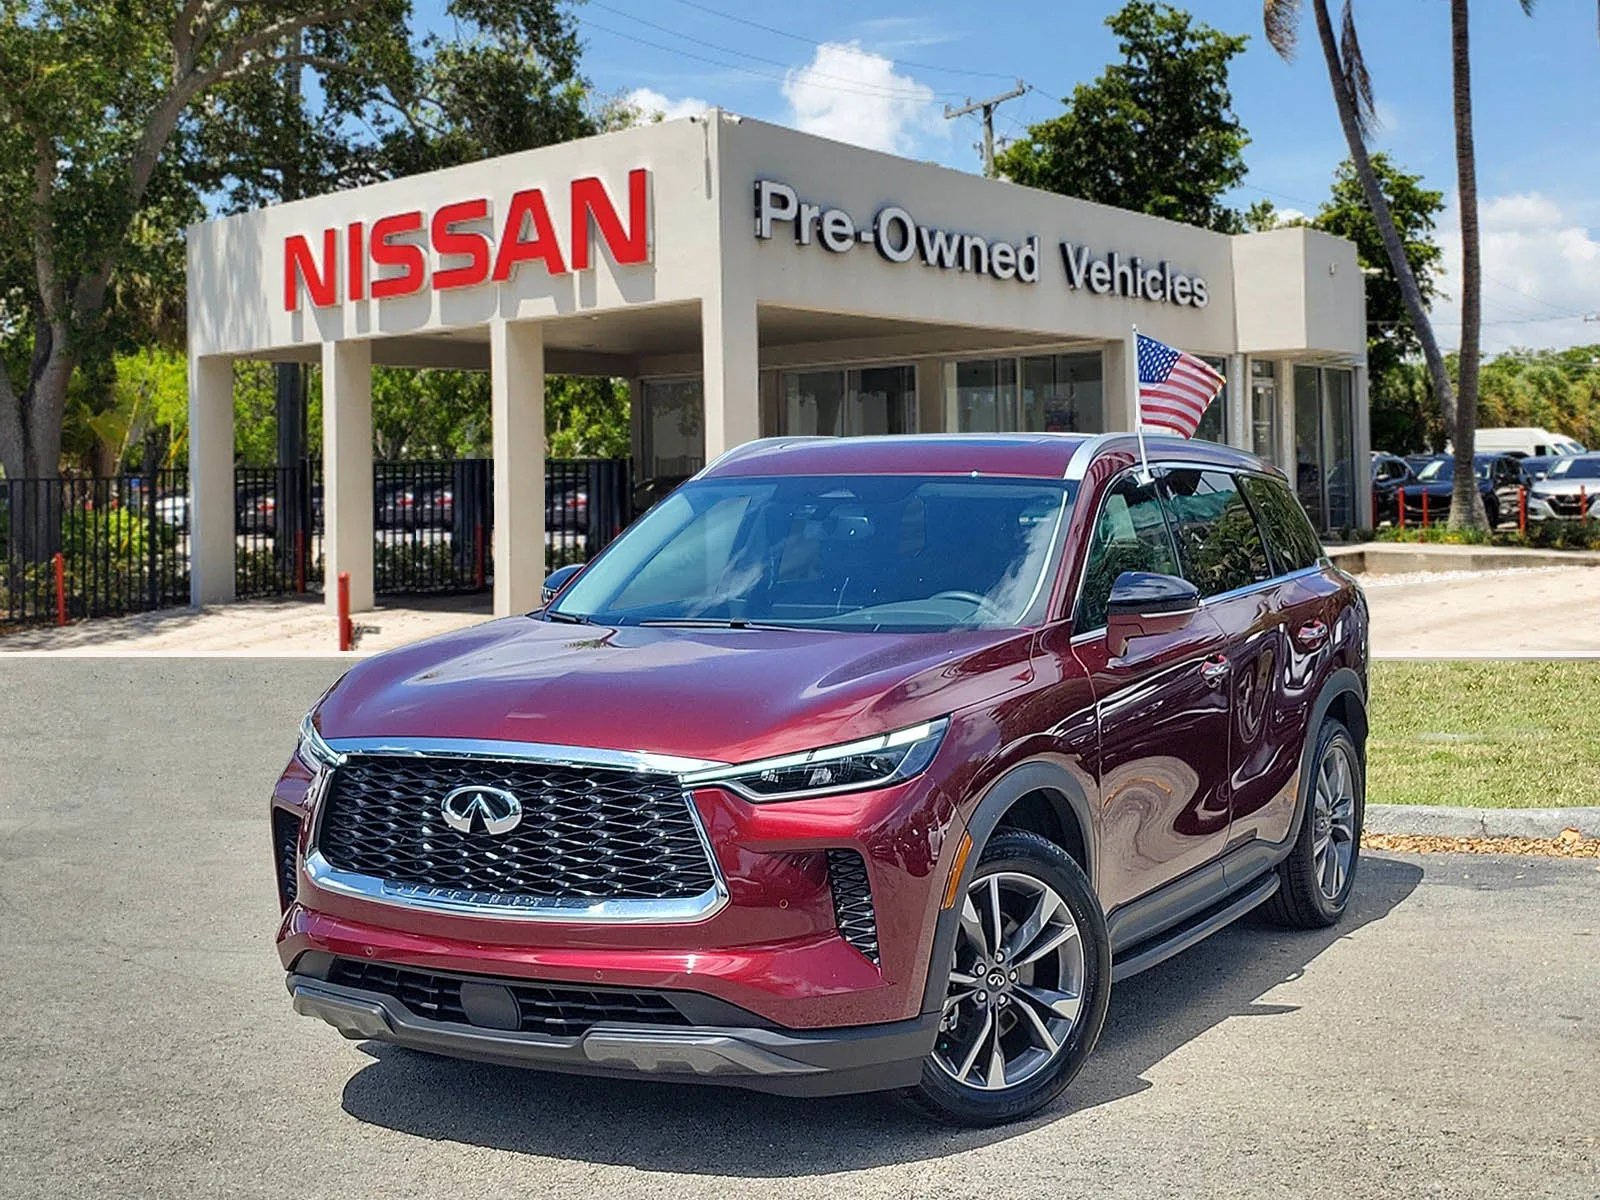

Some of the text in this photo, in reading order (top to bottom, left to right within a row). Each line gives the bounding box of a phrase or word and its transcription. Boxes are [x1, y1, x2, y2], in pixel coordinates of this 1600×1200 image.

[284, 168, 650, 312] NISSAN
[754, 179, 1209, 308] Pre-Owned Vehicles
